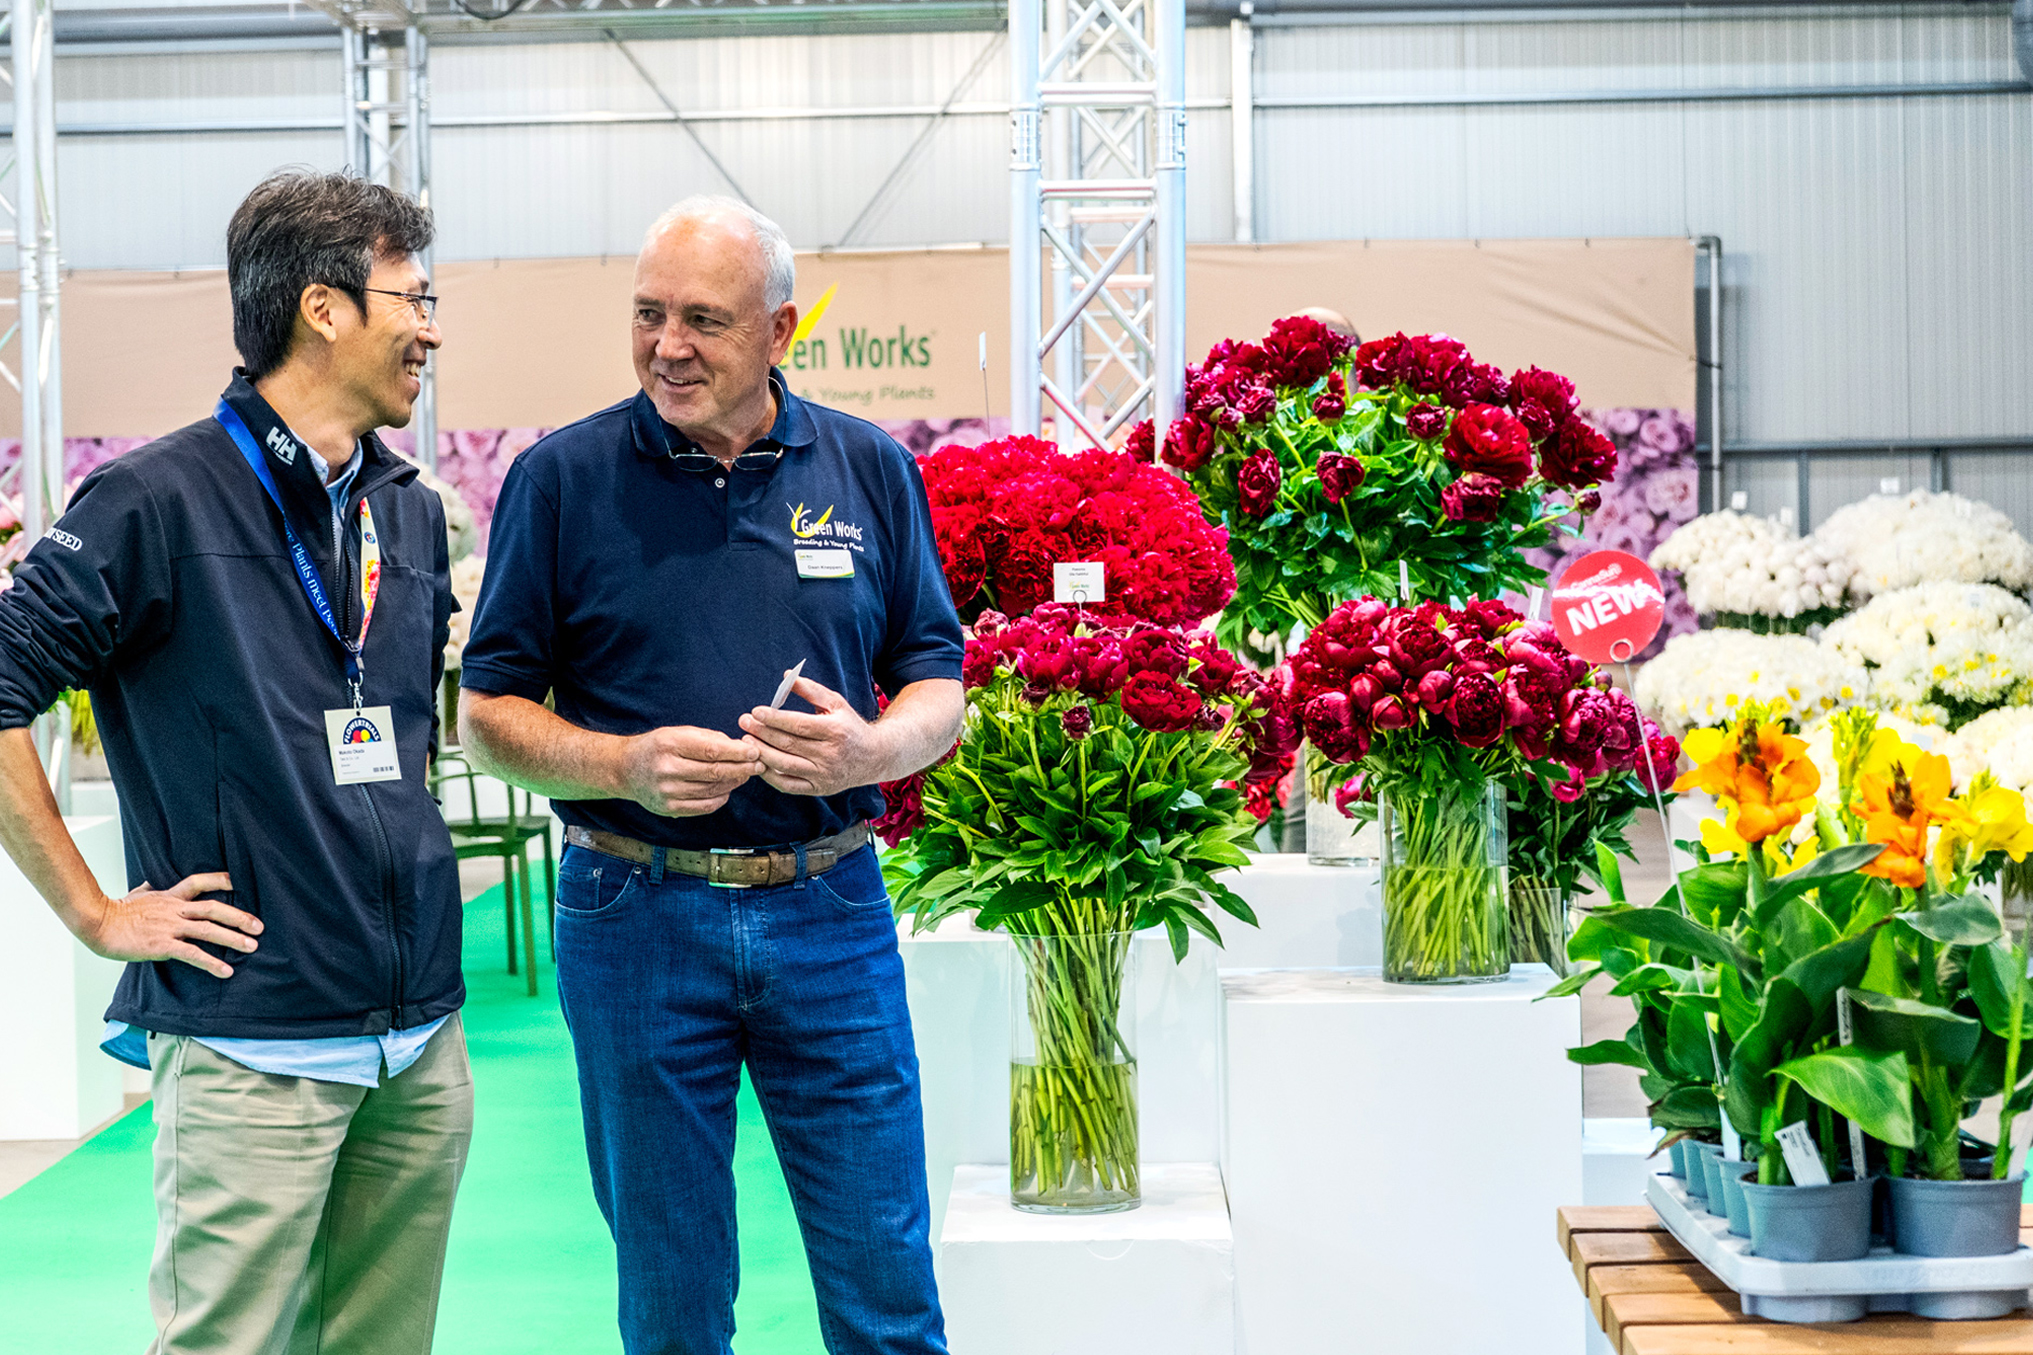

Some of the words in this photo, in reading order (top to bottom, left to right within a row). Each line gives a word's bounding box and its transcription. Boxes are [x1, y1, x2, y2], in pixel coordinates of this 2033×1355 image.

[839, 325, 930, 368] Works
[818, 387, 872, 405] Young
[879, 385, 935, 400] Plants
[52, 529, 83, 551] SEED
[801, 518, 833, 536] Green
[834, 520, 862, 541] Works
[793, 538, 822, 547] Breeding
[829, 539, 848, 550] Young
[849, 541, 865, 552] Plants
[292, 542, 313, 579] Plants
[307, 578, 327, 609] meet
[1566, 578, 1645, 636] NEW
[344, 719, 381, 744] FLOWERTRIALS
